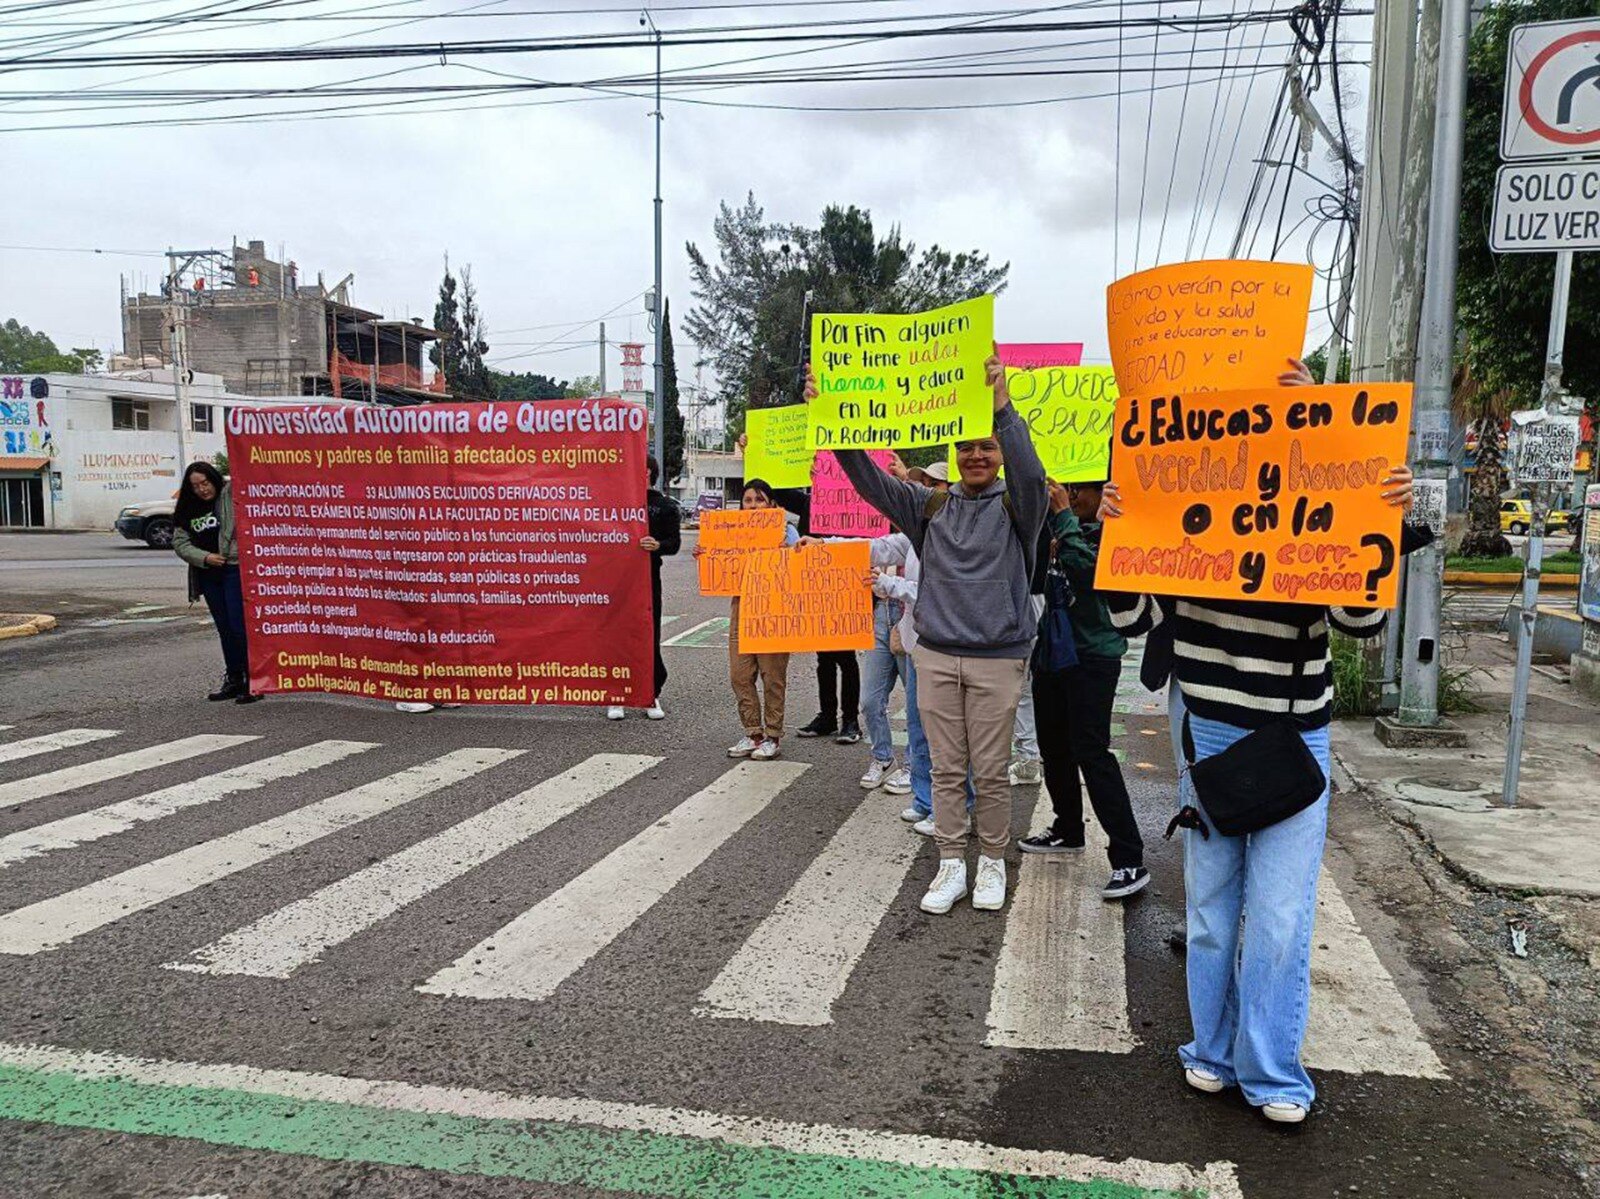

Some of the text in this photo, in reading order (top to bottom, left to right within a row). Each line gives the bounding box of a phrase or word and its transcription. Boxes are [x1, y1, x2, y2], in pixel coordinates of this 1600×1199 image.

[1507, 172, 1575, 203] SOLO
[1504, 210, 1600, 242] LUZ VER
[1167, 274, 1222, 299] verán
[1230, 279, 1267, 300] por
[1273, 281, 1291, 297] la
[1133, 301, 1255, 327] vida y la salud
[820, 317, 849, 344] Por
[898, 314, 971, 344] alguien
[1149, 332, 1158, 342] se
[1164, 325, 1226, 340] educaron
[1232, 327, 1248, 338] en
[1255, 325, 1266, 338] la
[822, 351, 852, 371] que
[861, 348, 901, 368] tiene
[1124, 350, 1187, 393] ERDAD
[1203, 351, 1214, 366] y
[1227, 350, 1244, 365] el
[820, 367, 964, 396] honor y educa
[227, 404, 350, 436] Universidad
[477, 403, 509, 433] de
[516, 400, 644, 435] Querétaro
[838, 390, 959, 419] en la verdad
[1121, 390, 1398, 448] ¿Educas en la
[815, 425, 837, 446] Dr.
[841, 424, 902, 447] Rodrigo
[910, 416, 964, 442] Miguel
[1047, 406, 1114, 436] PARA
[250, 445, 624, 469] Alumnos padres de familia afectados exigimos:
[1134, 437, 1389, 502] verdad y honor
[248, 481, 592, 501] INCORPORACIÓN DE 33 ALUMNOS EXCLUIDOS DERIVADOS DEL
[245, 501, 646, 523] TRÁFICO DEL EXÁMEN DE ADMISIÓN LA FACULTAD DE MEDICINA DE LA UAQ
[1181, 495, 1334, 537] o en la
[252, 523, 630, 544] Inhabilitación permanente del servicio público los funcionarios involucrados
[254, 543, 587, 565] Destitución alumnos que ingresaron con prácticas fraudulentas
[1110, 536, 1358, 595] mentira y corr-
[256, 563, 580, 586] Castigo ejemplar partes involucradas, sean públicas privadas
[258, 582, 610, 607] Disculpa pública todos afectados: alumnos, familias, contribuyentes
[264, 601, 358, 618] sociedad general
[321, 622, 374, 638] salvaguardar
[384, 628, 418, 643] derecho
[439, 629, 495, 645] educación
[278, 651, 631, 681] Cumplan las demandas plenamente justificadas en
[278, 673, 607, 702] la obligación de "Educar en la verdad el honor
